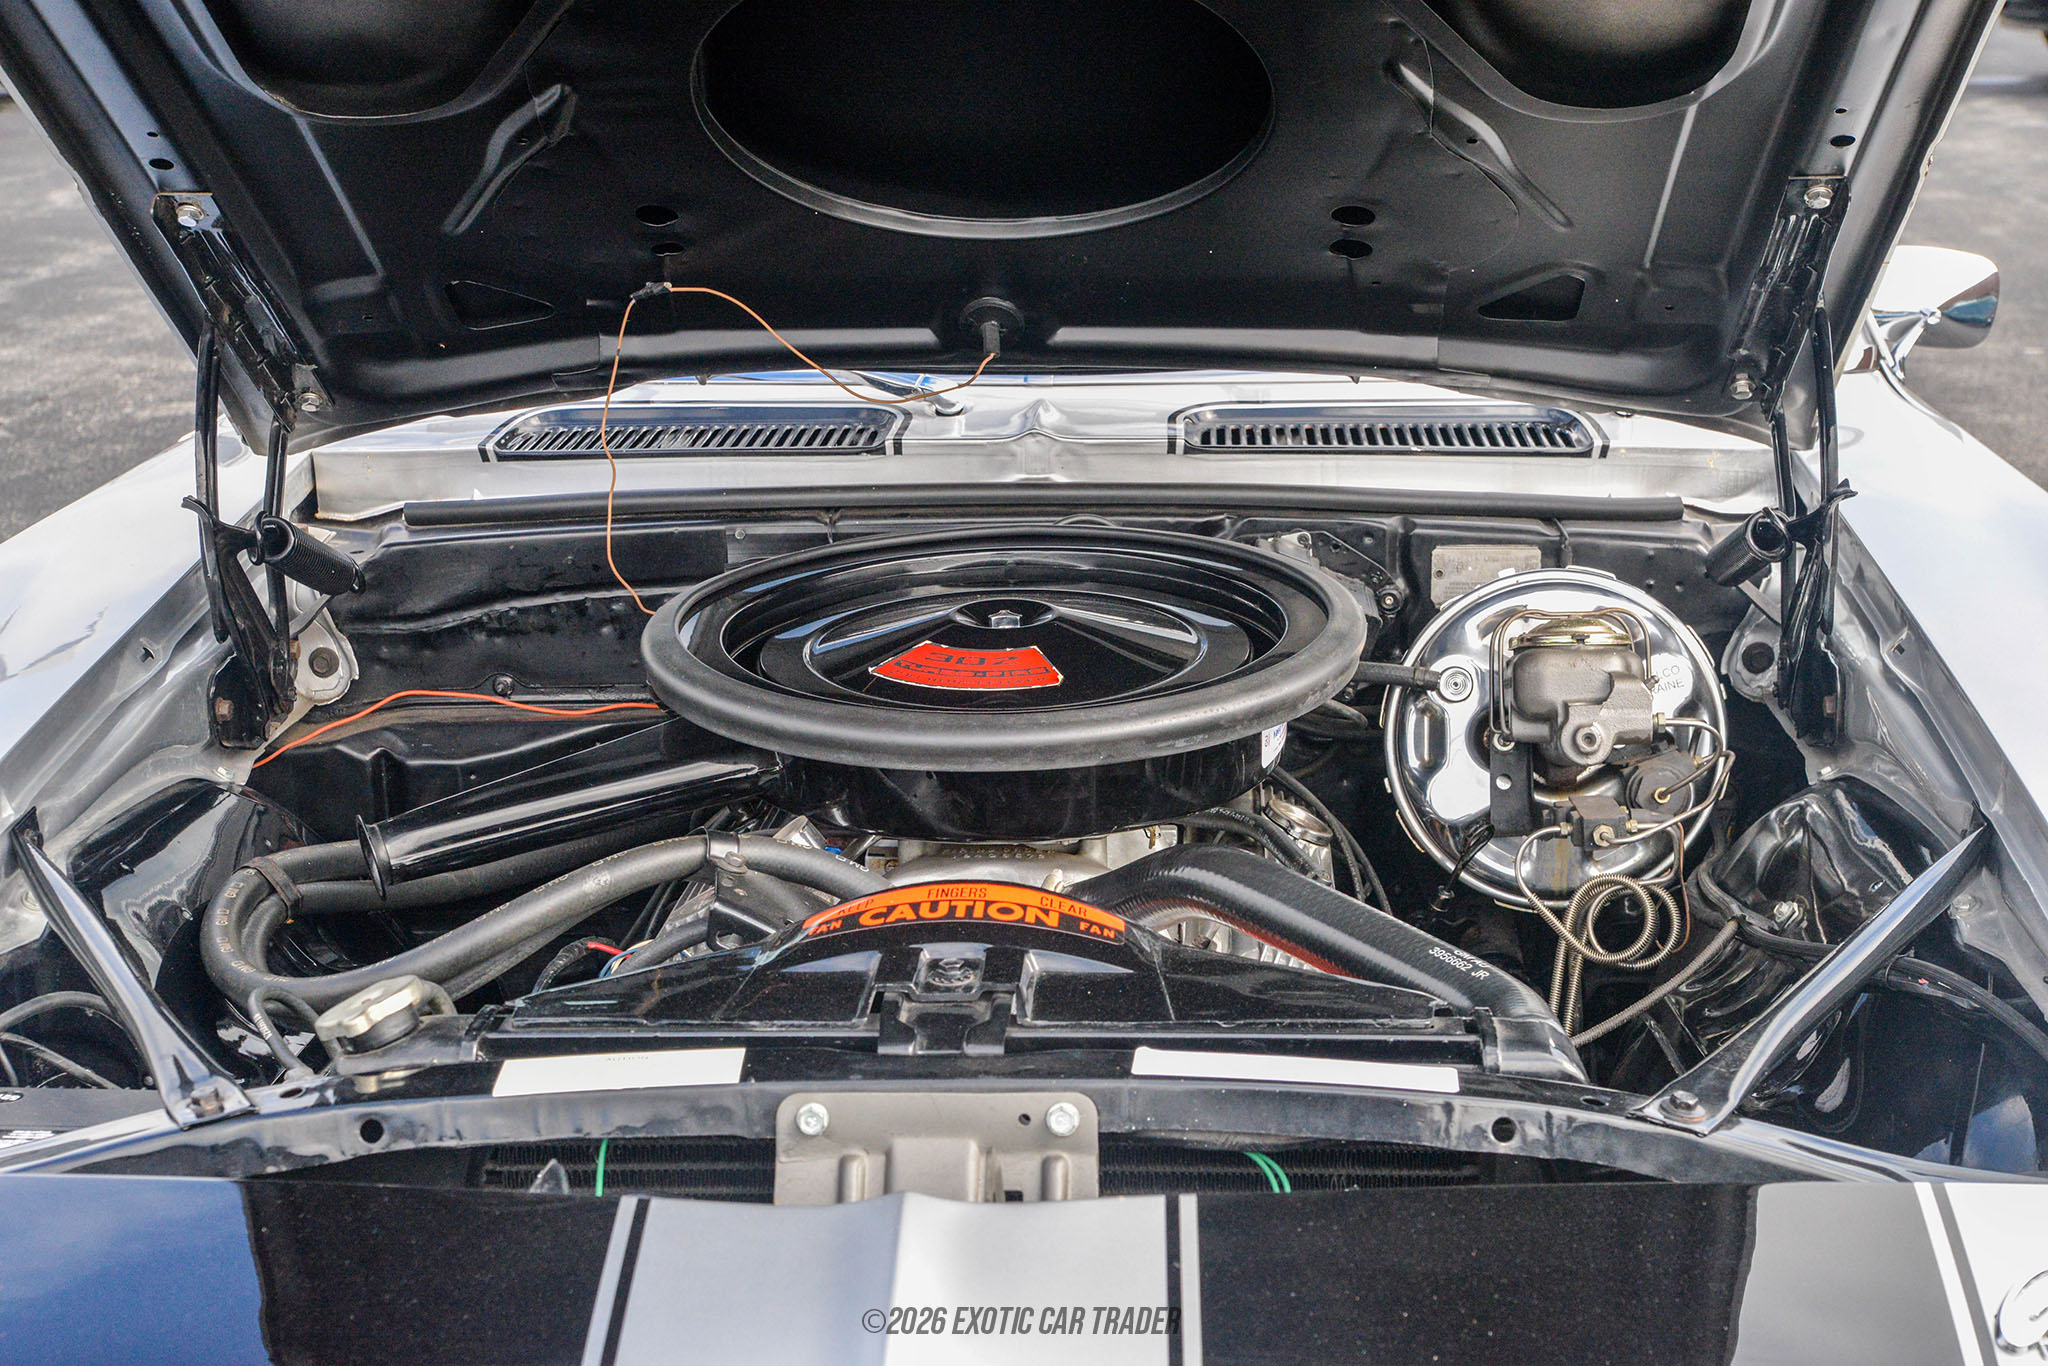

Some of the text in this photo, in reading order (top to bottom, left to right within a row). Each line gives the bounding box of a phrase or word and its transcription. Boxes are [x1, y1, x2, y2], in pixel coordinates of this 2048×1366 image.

[927, 886, 988, 899] FINGERS
[1040, 895, 1088, 917] CLEAR
[808, 900, 1116, 939] FAN CAUTION FAN
[1428, 946, 1473, 972] 3956662
[1471, 969, 1490, 981] JR
